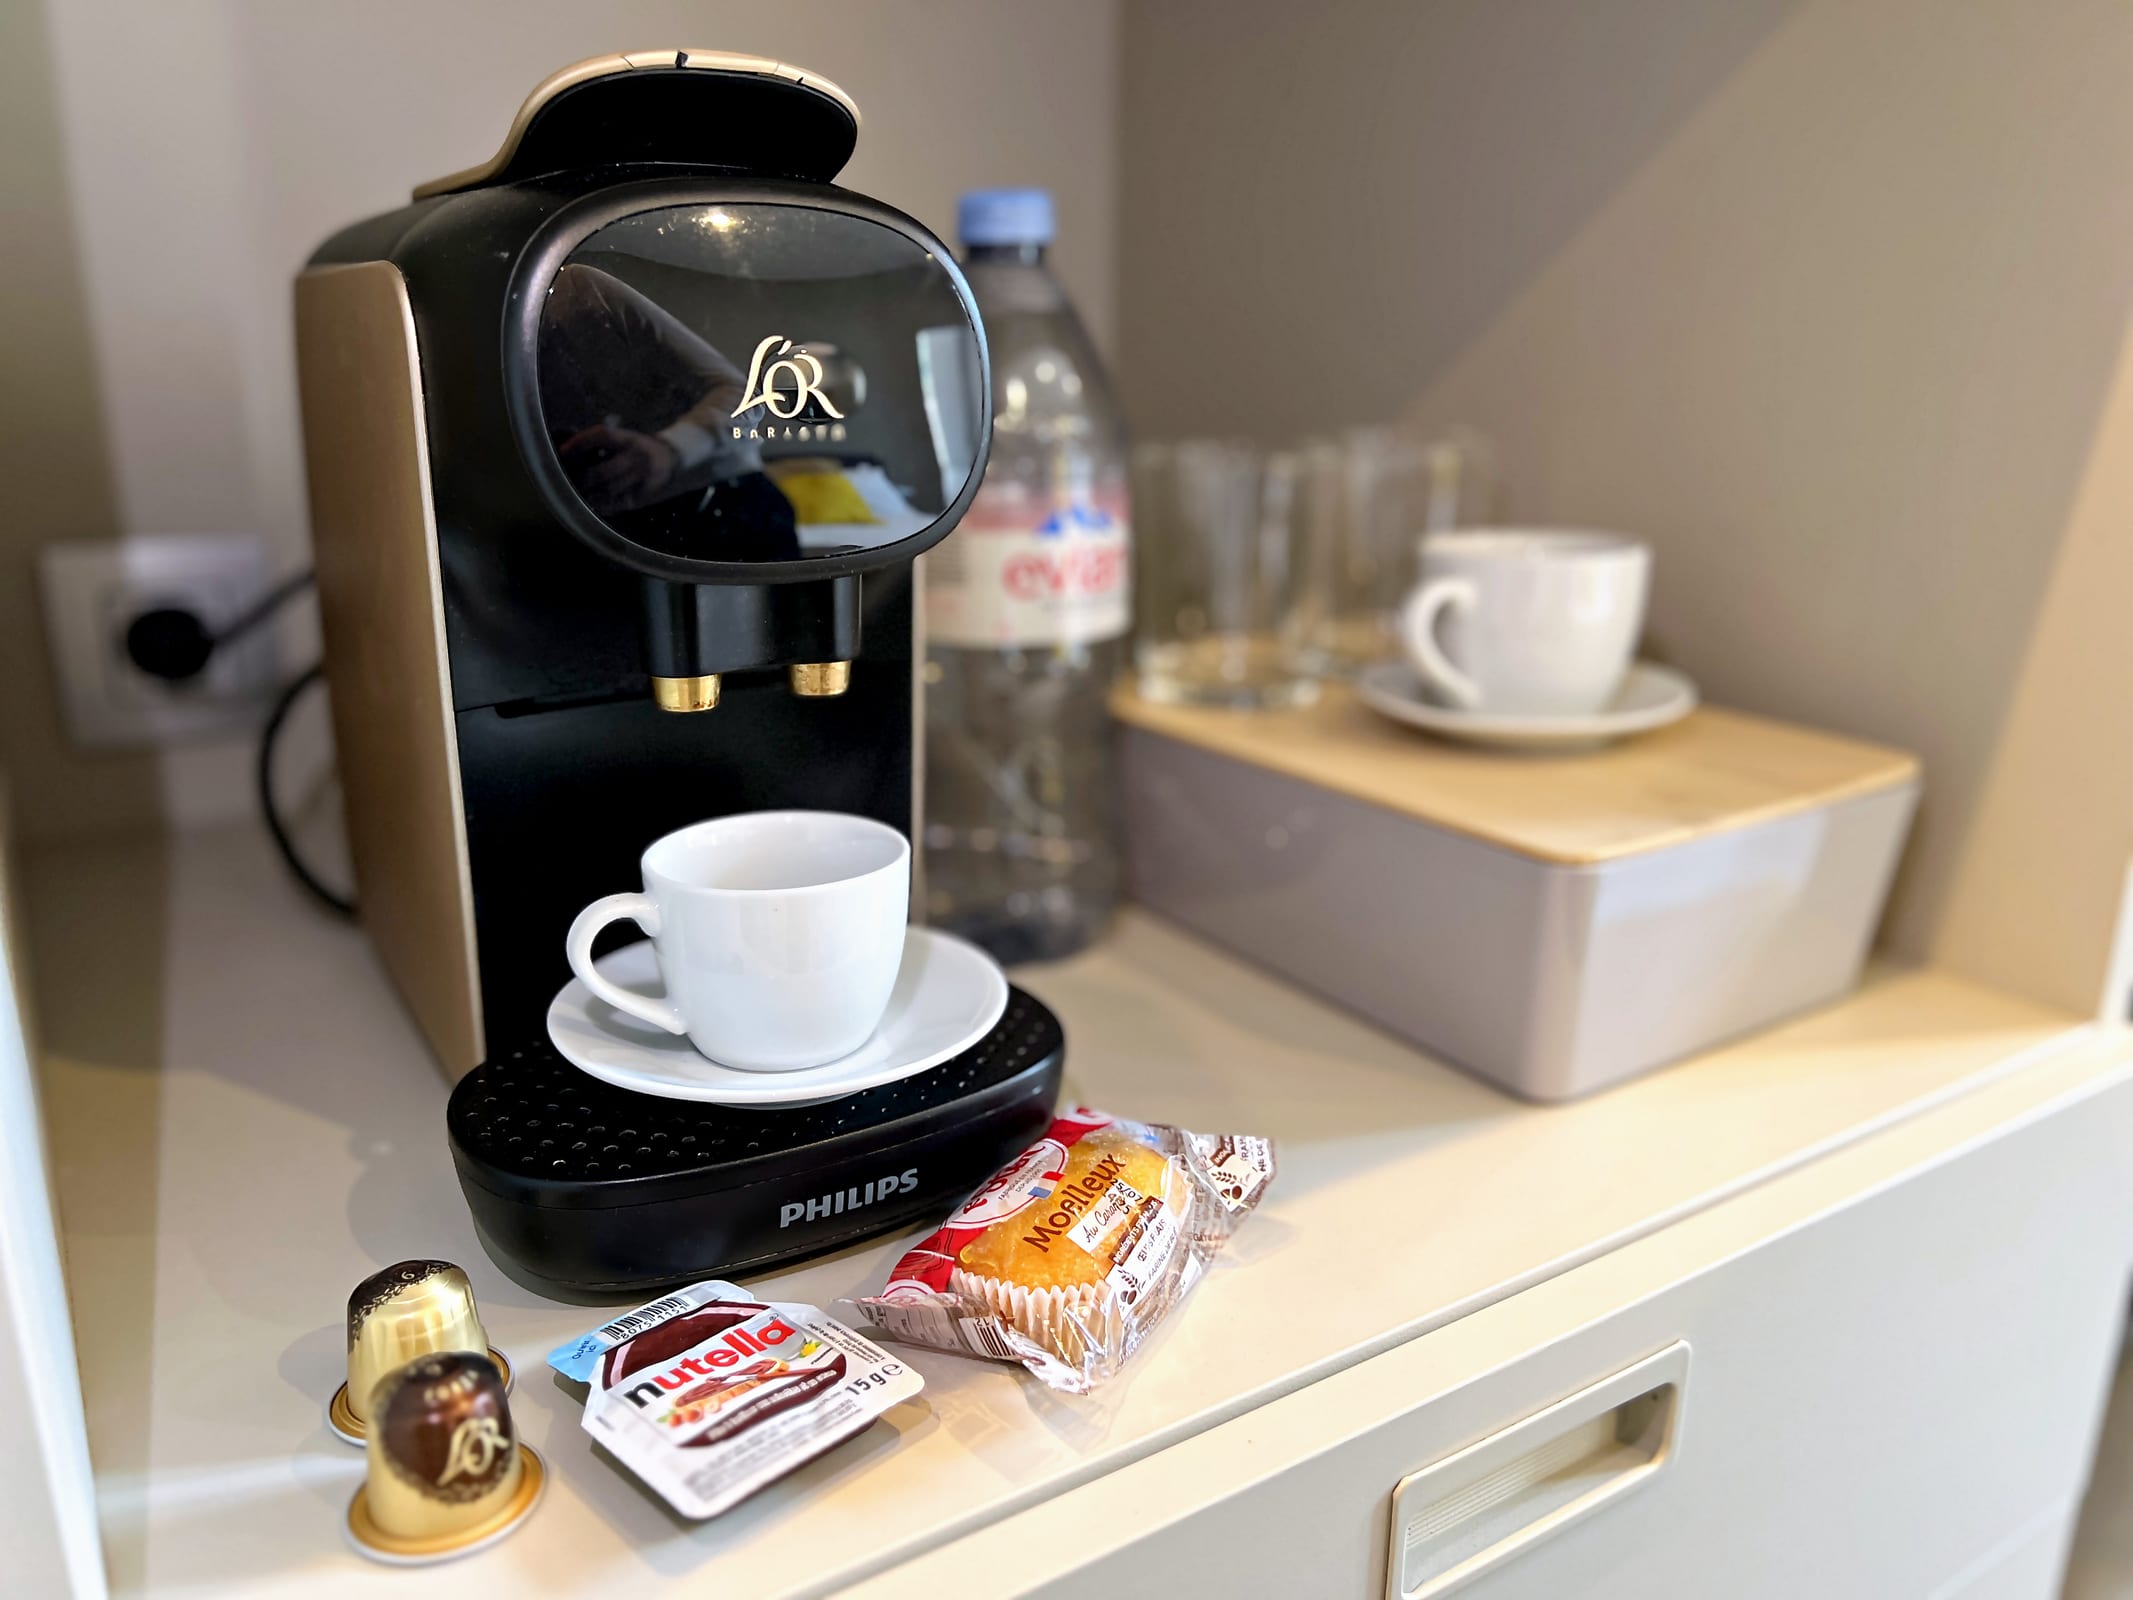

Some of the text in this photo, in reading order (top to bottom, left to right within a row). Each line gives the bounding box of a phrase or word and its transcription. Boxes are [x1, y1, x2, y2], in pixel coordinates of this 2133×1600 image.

[779, 1168, 918, 1228] PHILIPS
[1022, 1153, 1127, 1253] Moelleux
[623, 1319, 796, 1409] nutella
[845, 1372, 887, 1395] 15 g
